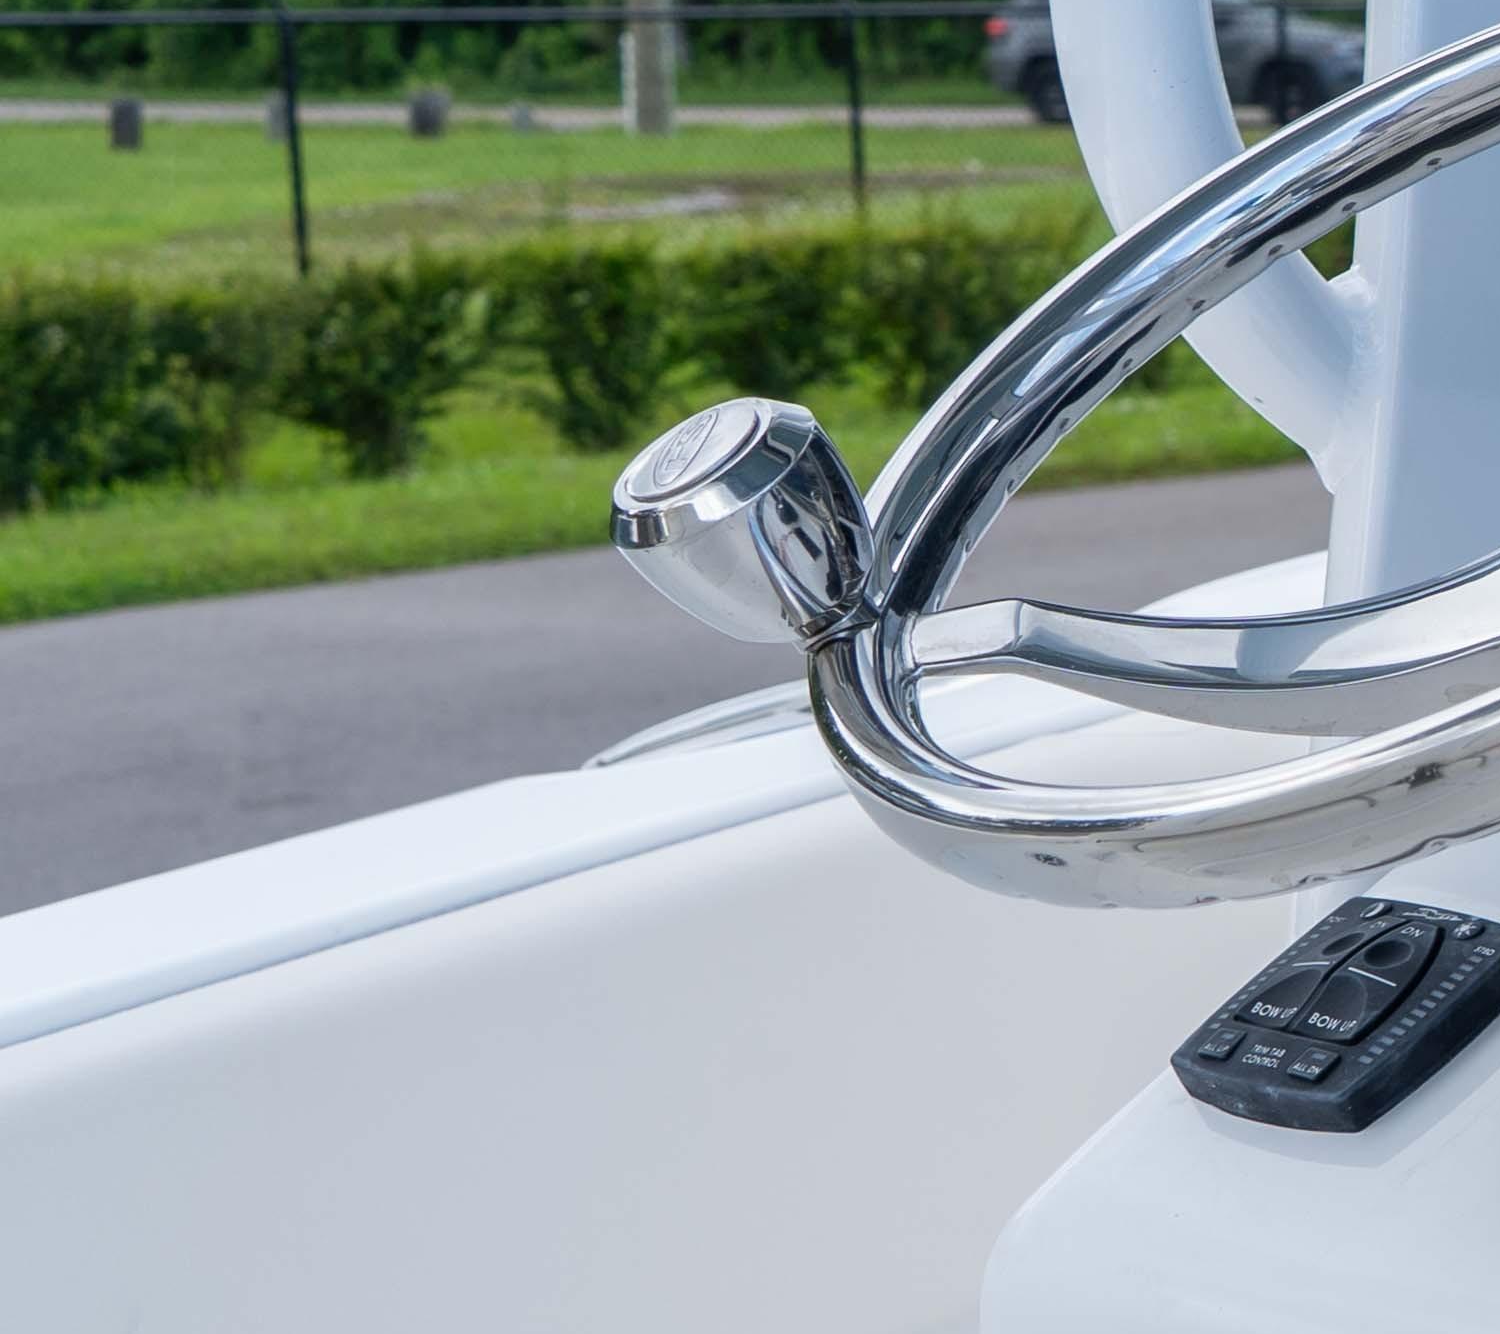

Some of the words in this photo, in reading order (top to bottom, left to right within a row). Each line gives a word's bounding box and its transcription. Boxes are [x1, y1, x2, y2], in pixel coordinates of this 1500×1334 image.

[1250, 1002, 1281, 1018] BOW
[1281, 1006, 1298, 1019] UP
[1308, 1012, 1339, 1030] BOW
[1340, 1019, 1357, 1032] UP
